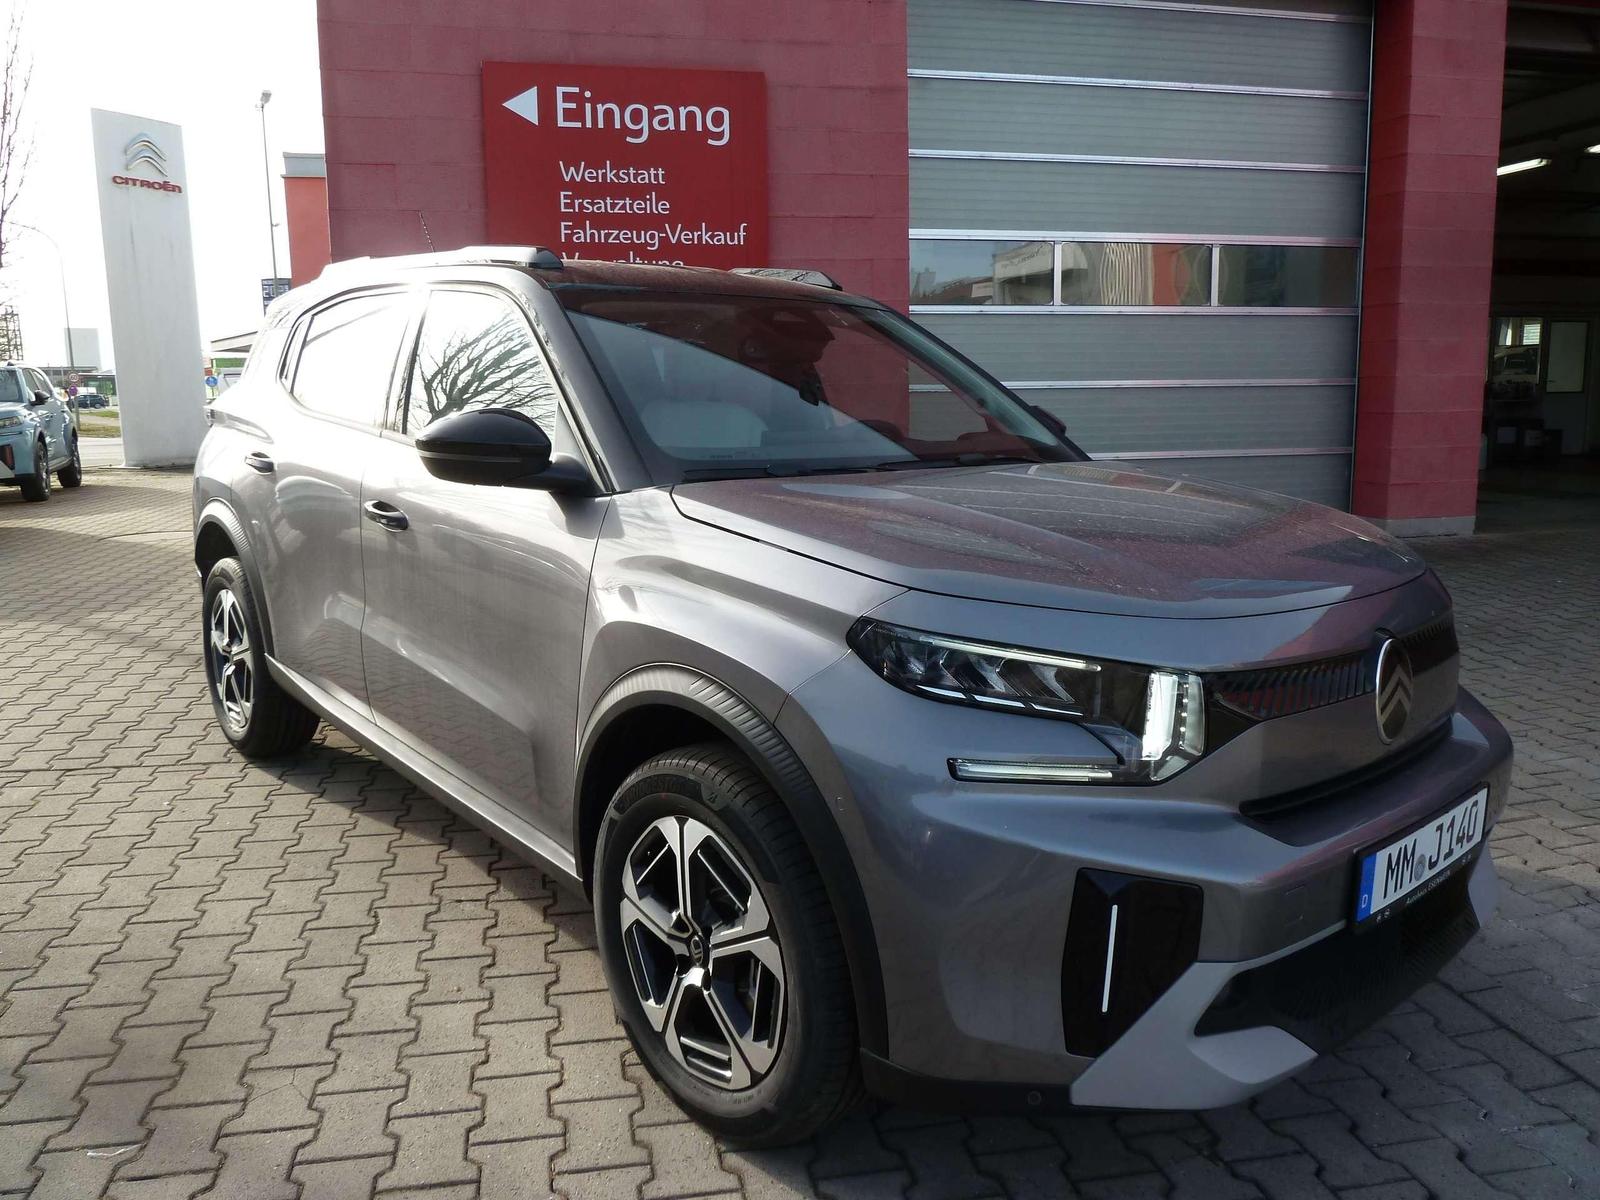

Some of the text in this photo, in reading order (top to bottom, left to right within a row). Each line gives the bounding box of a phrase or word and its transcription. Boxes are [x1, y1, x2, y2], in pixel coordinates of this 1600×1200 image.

[556, 86, 730, 146] Eingang
[559, 160, 666, 185] Werkstatt
[559, 191, 671, 215] Ersatzteile
[559, 220, 748, 251] Fahrzeug-Verkauf
[1361, 894, 1369, 908] D
[1383, 838, 1417, 899] MM
